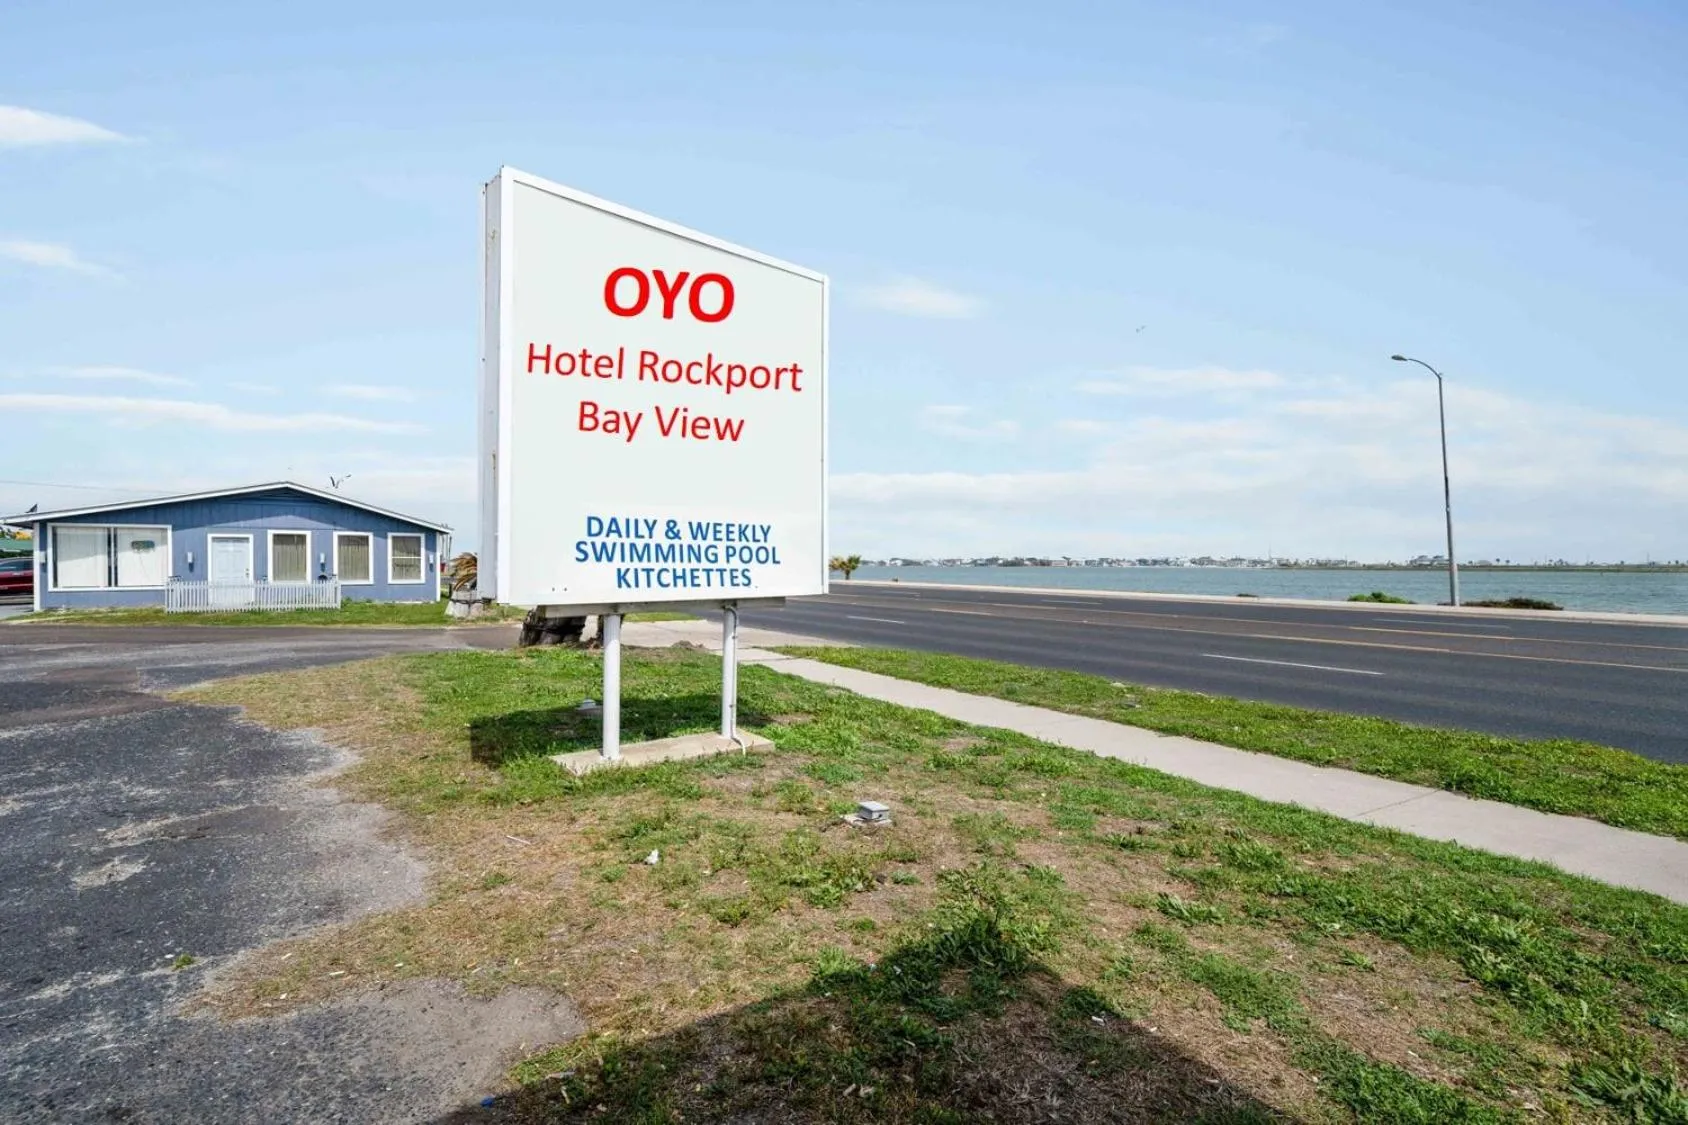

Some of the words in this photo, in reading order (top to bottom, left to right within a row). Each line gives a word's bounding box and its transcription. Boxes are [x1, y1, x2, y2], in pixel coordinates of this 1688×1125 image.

[602, 266, 736, 324] OYO
[527, 343, 625, 379] Hotel
[638, 350, 803, 394] Rockport
[577, 400, 643, 443] Bay
[654, 406, 745, 442] View
[586, 515, 658, 540] DAILY
[664, 519, 682, 541] &
[688, 521, 772, 543] WEEKLY
[575, 540, 719, 564] SWIMMING
[725, 544, 781, 565] POOL
[616, 567, 752, 588] KITCHETTES
